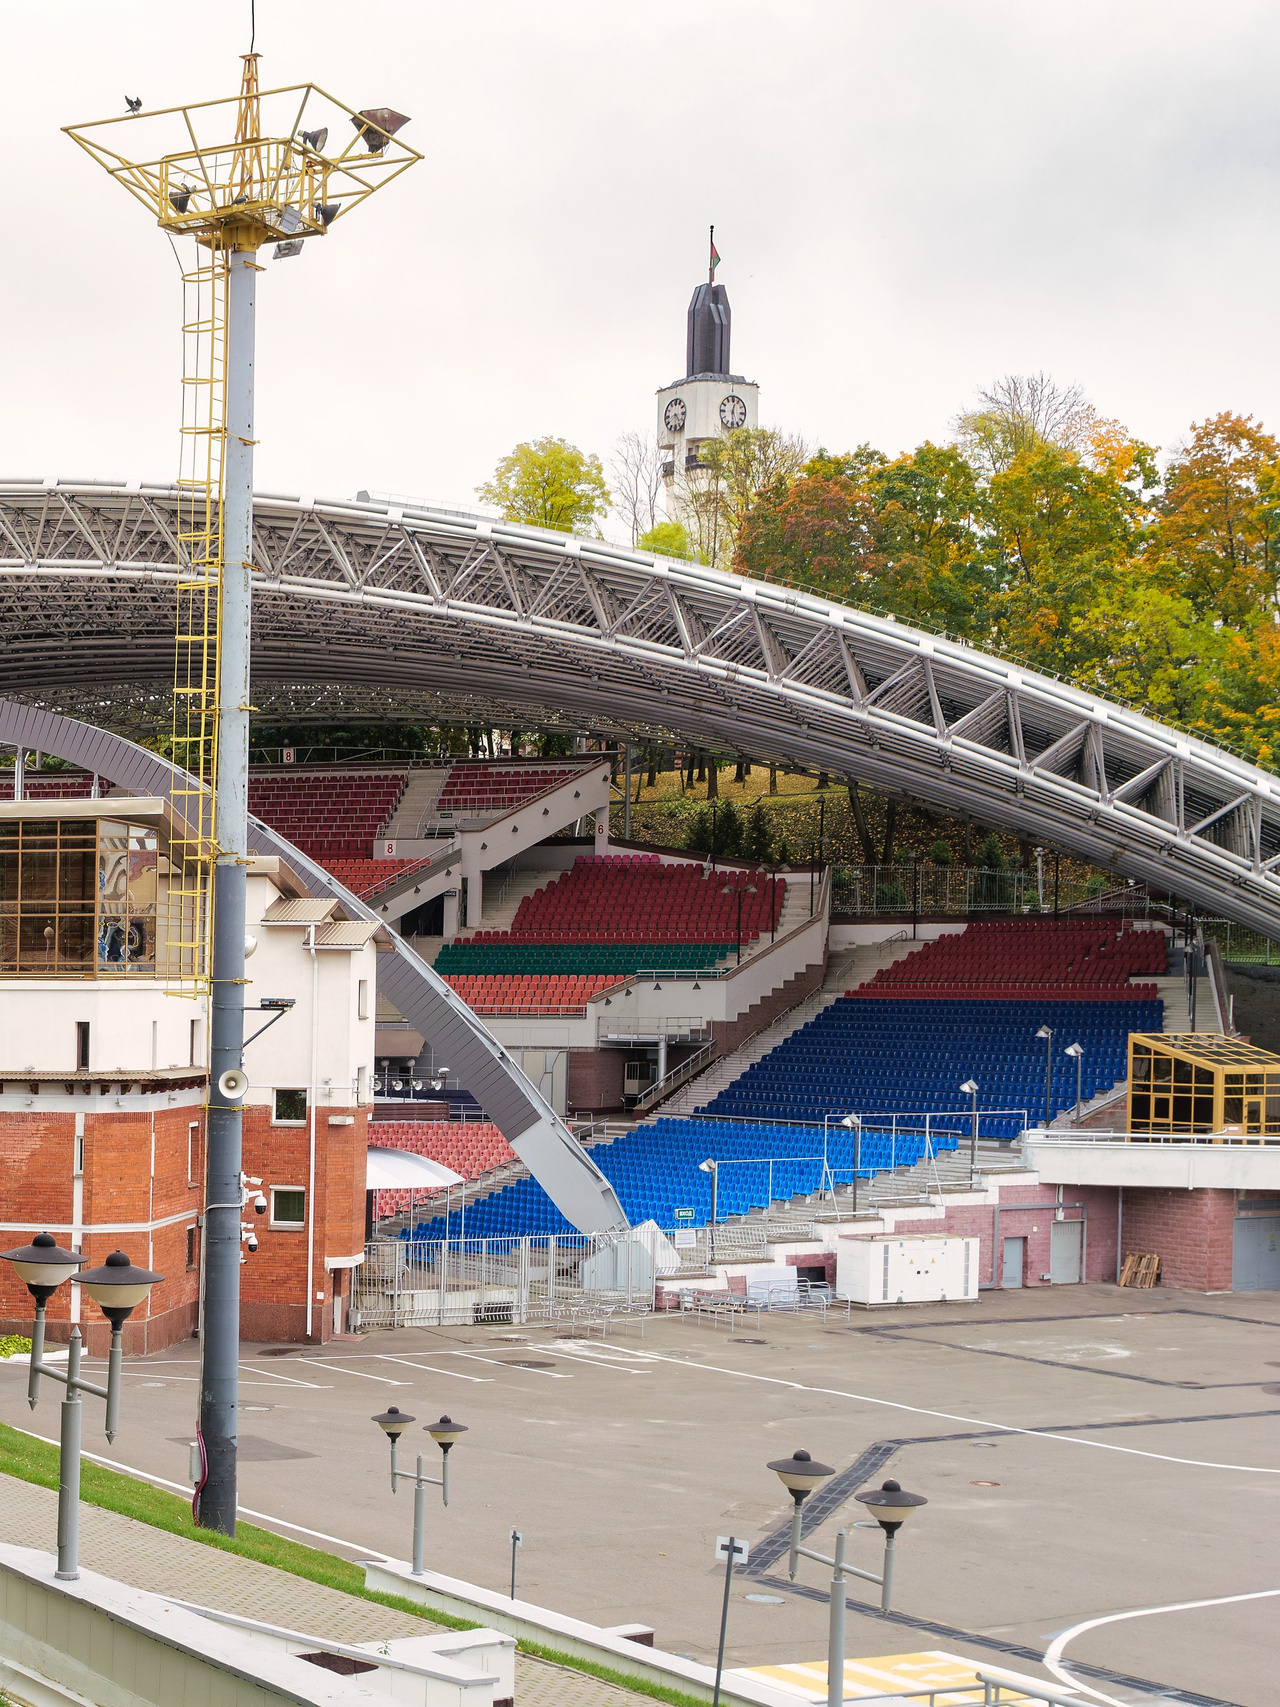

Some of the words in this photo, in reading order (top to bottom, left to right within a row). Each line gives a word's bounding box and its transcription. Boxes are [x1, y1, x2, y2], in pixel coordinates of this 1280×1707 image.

[286, 752, 291, 761] 8
[598, 825, 604, 834] 6
[387, 843, 393, 853] 8
